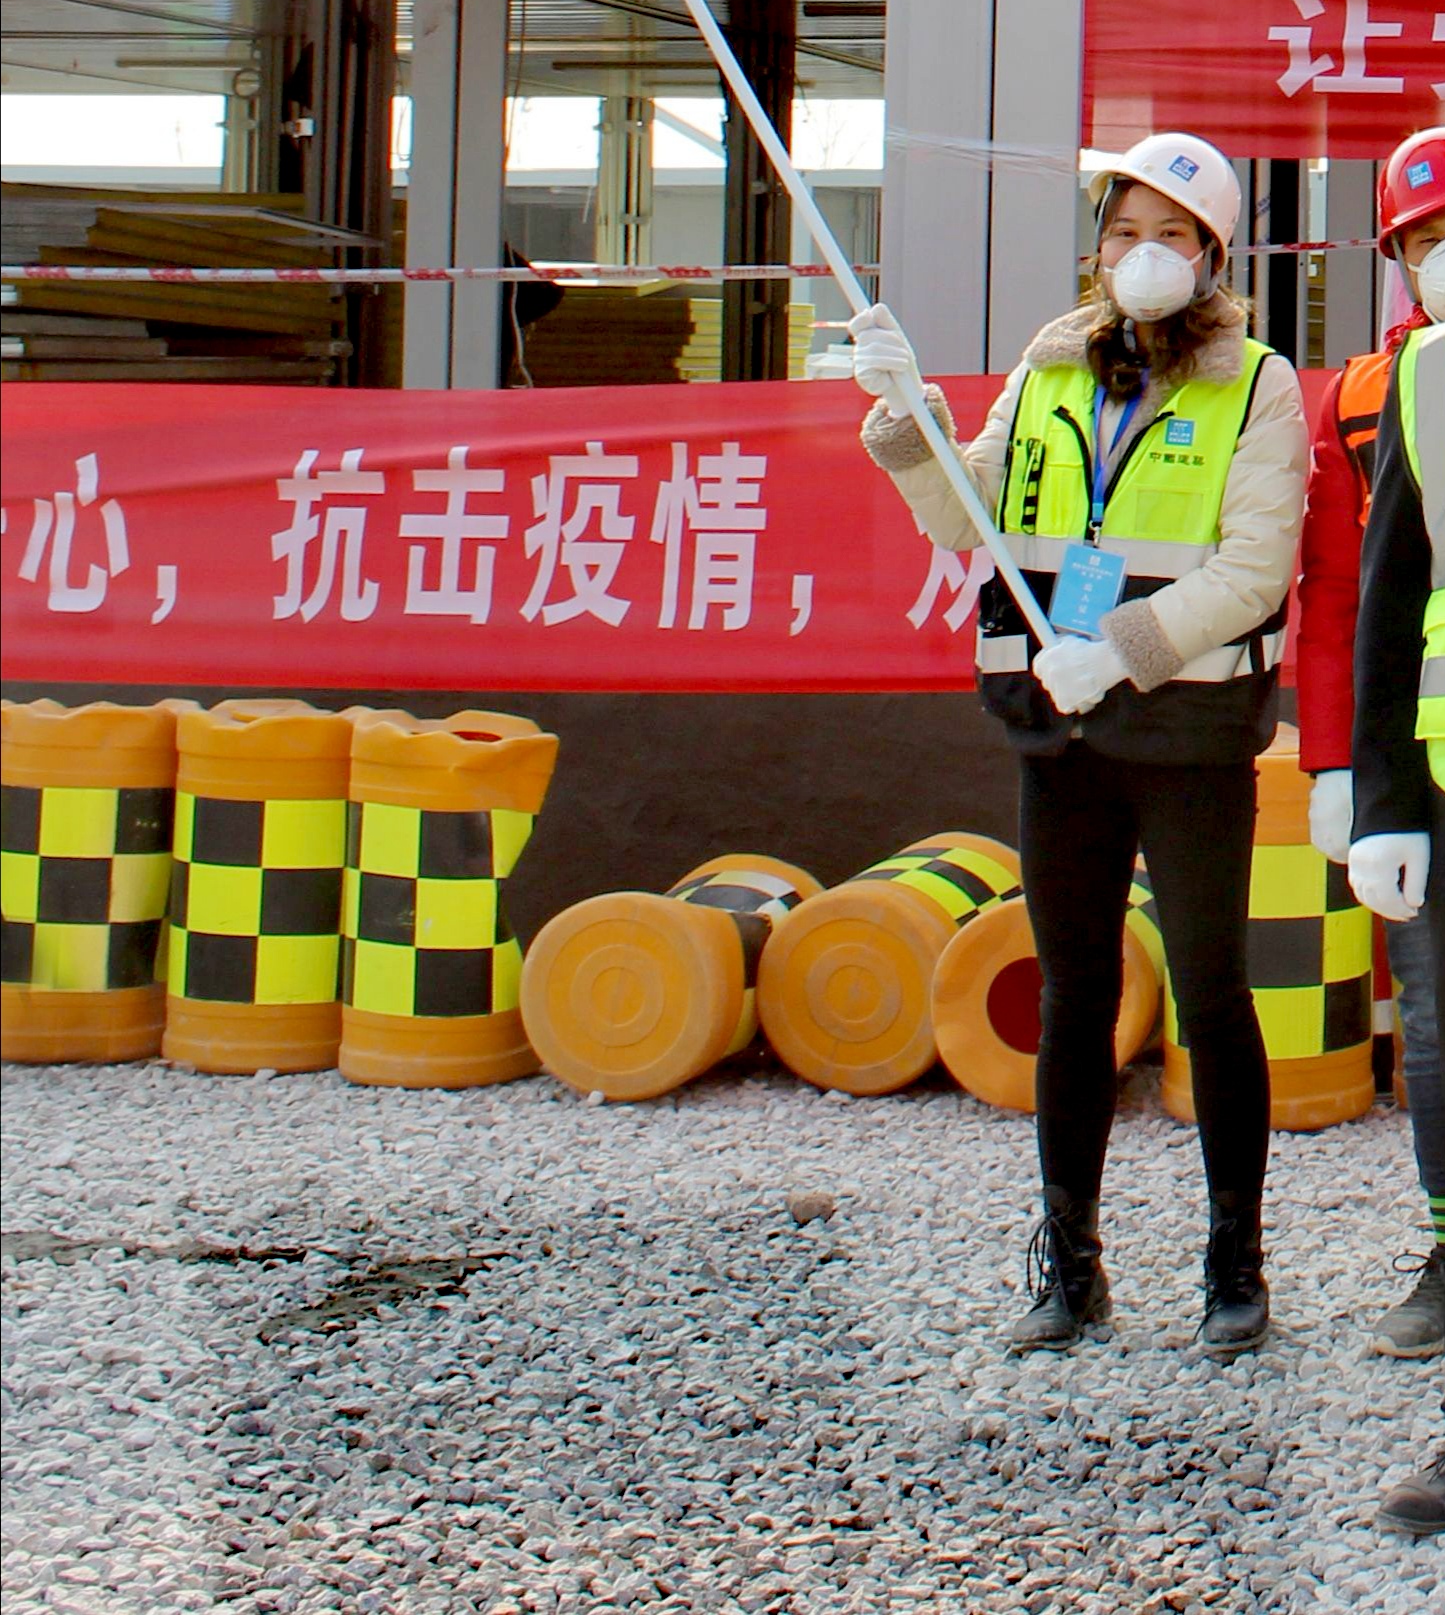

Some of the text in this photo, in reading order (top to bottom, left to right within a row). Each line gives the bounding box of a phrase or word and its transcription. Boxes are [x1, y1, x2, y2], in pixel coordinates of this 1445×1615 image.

[0, 441, 995, 636] 心，抗击疫情，
